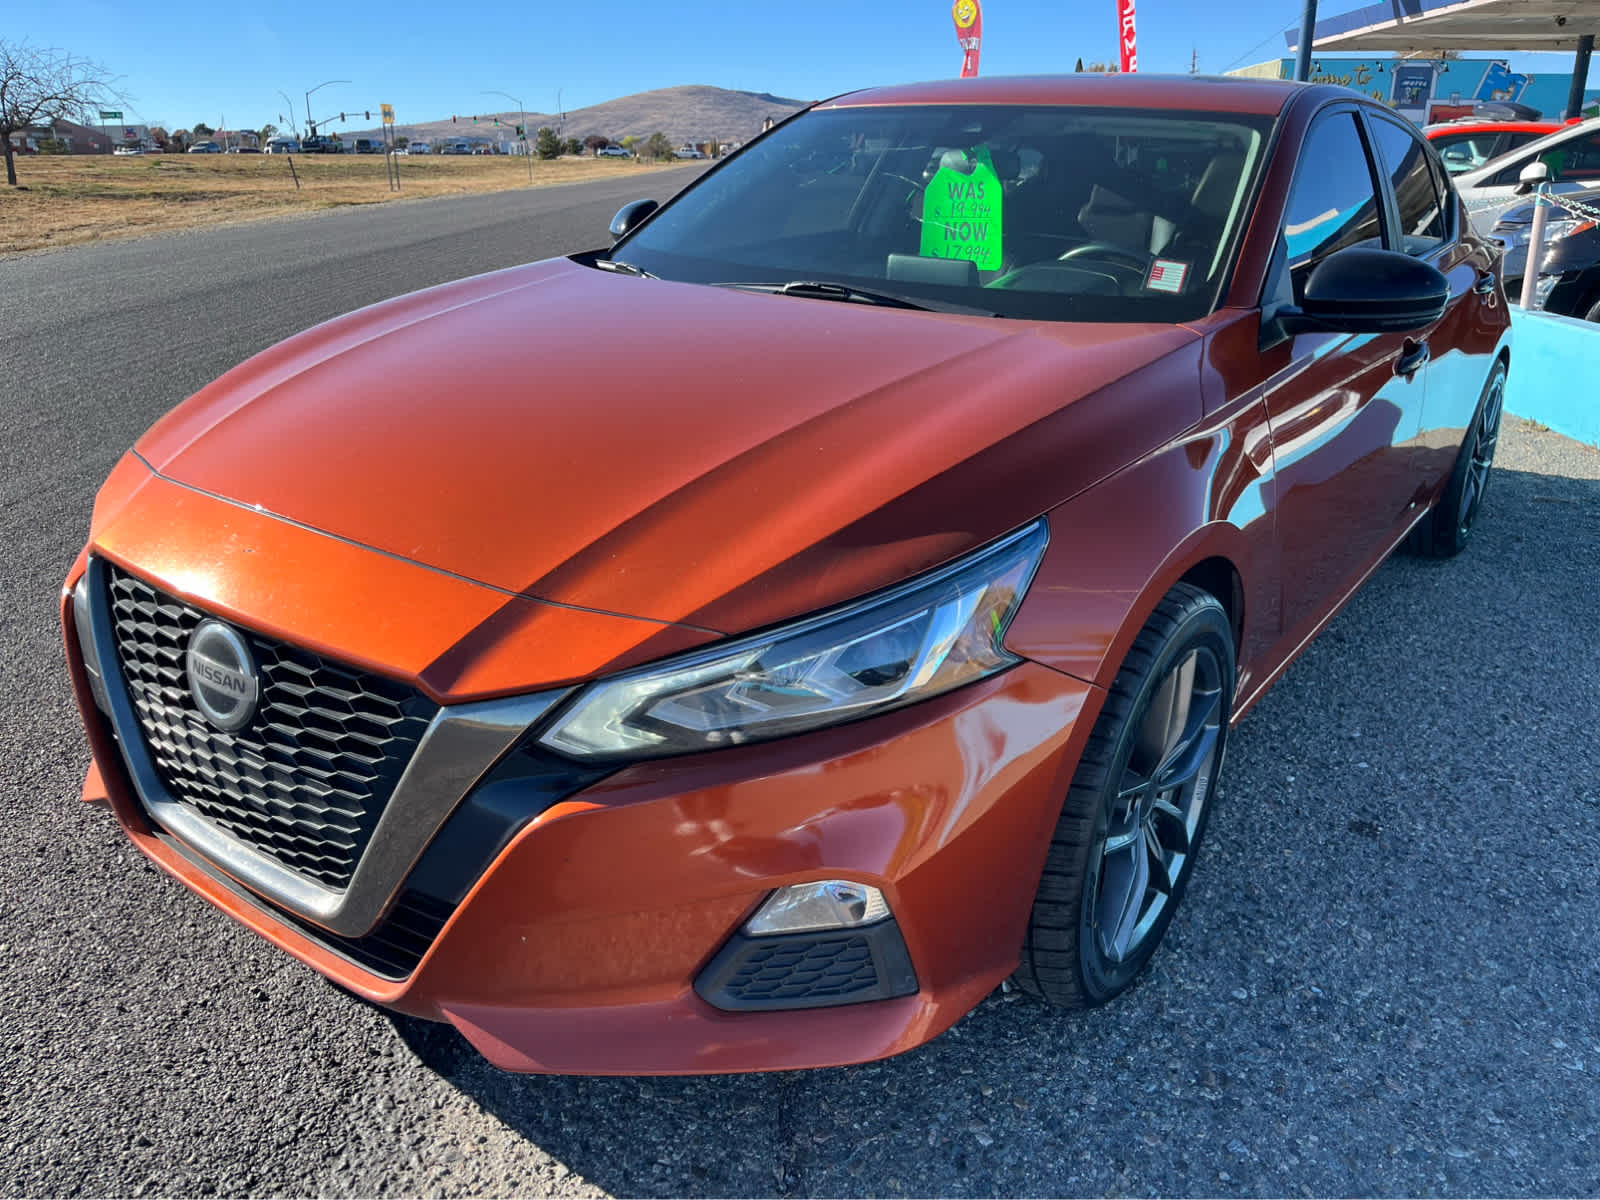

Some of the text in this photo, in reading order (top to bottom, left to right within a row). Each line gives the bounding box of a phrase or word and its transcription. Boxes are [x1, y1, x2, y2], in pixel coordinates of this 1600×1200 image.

[948, 181, 985, 200] WAS
[944, 221, 989, 241] NOW
[192, 659, 246, 693] NISSAN
